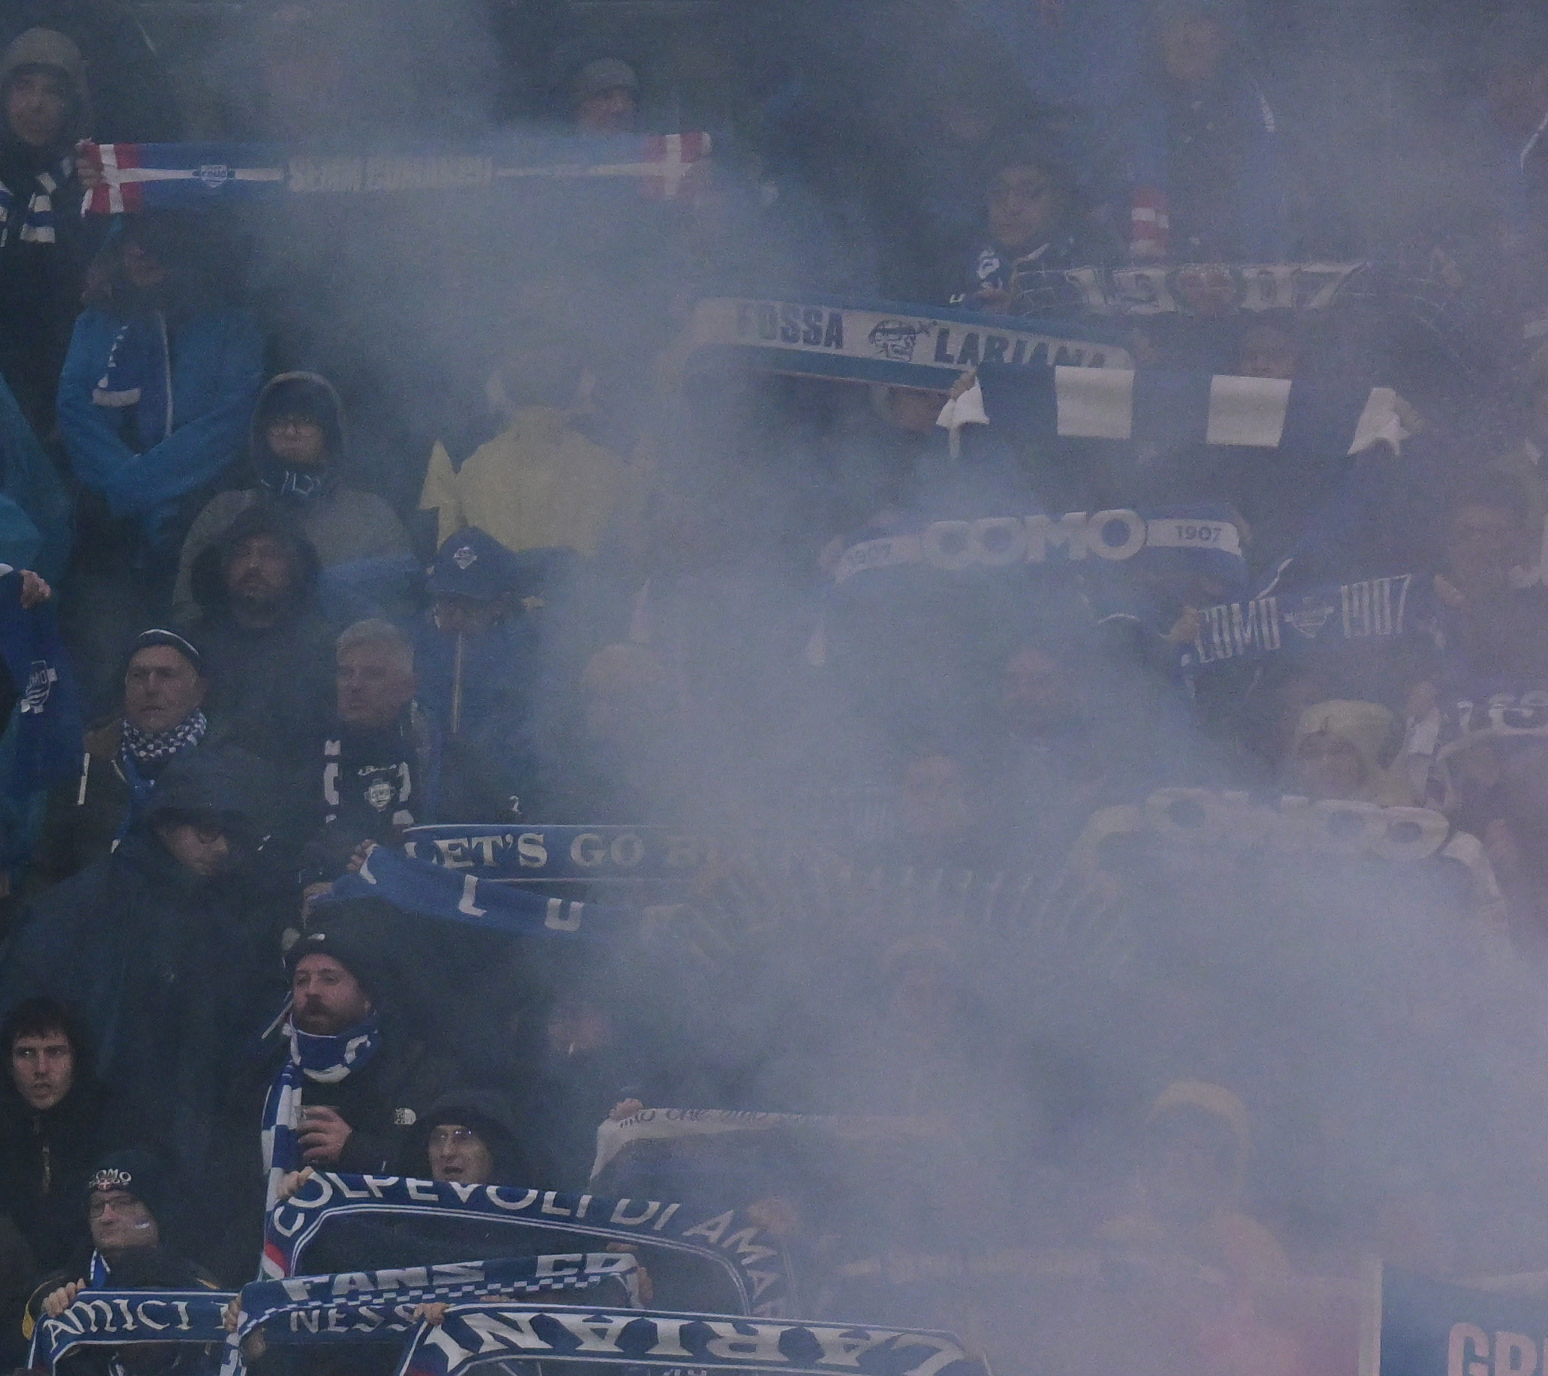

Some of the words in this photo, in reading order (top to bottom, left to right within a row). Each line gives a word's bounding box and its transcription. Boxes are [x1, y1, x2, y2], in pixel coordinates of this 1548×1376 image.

[738, 303, 843, 350] FOSSA
[922, 507, 1148, 567] COMO
[570, 831, 644, 869] GO
